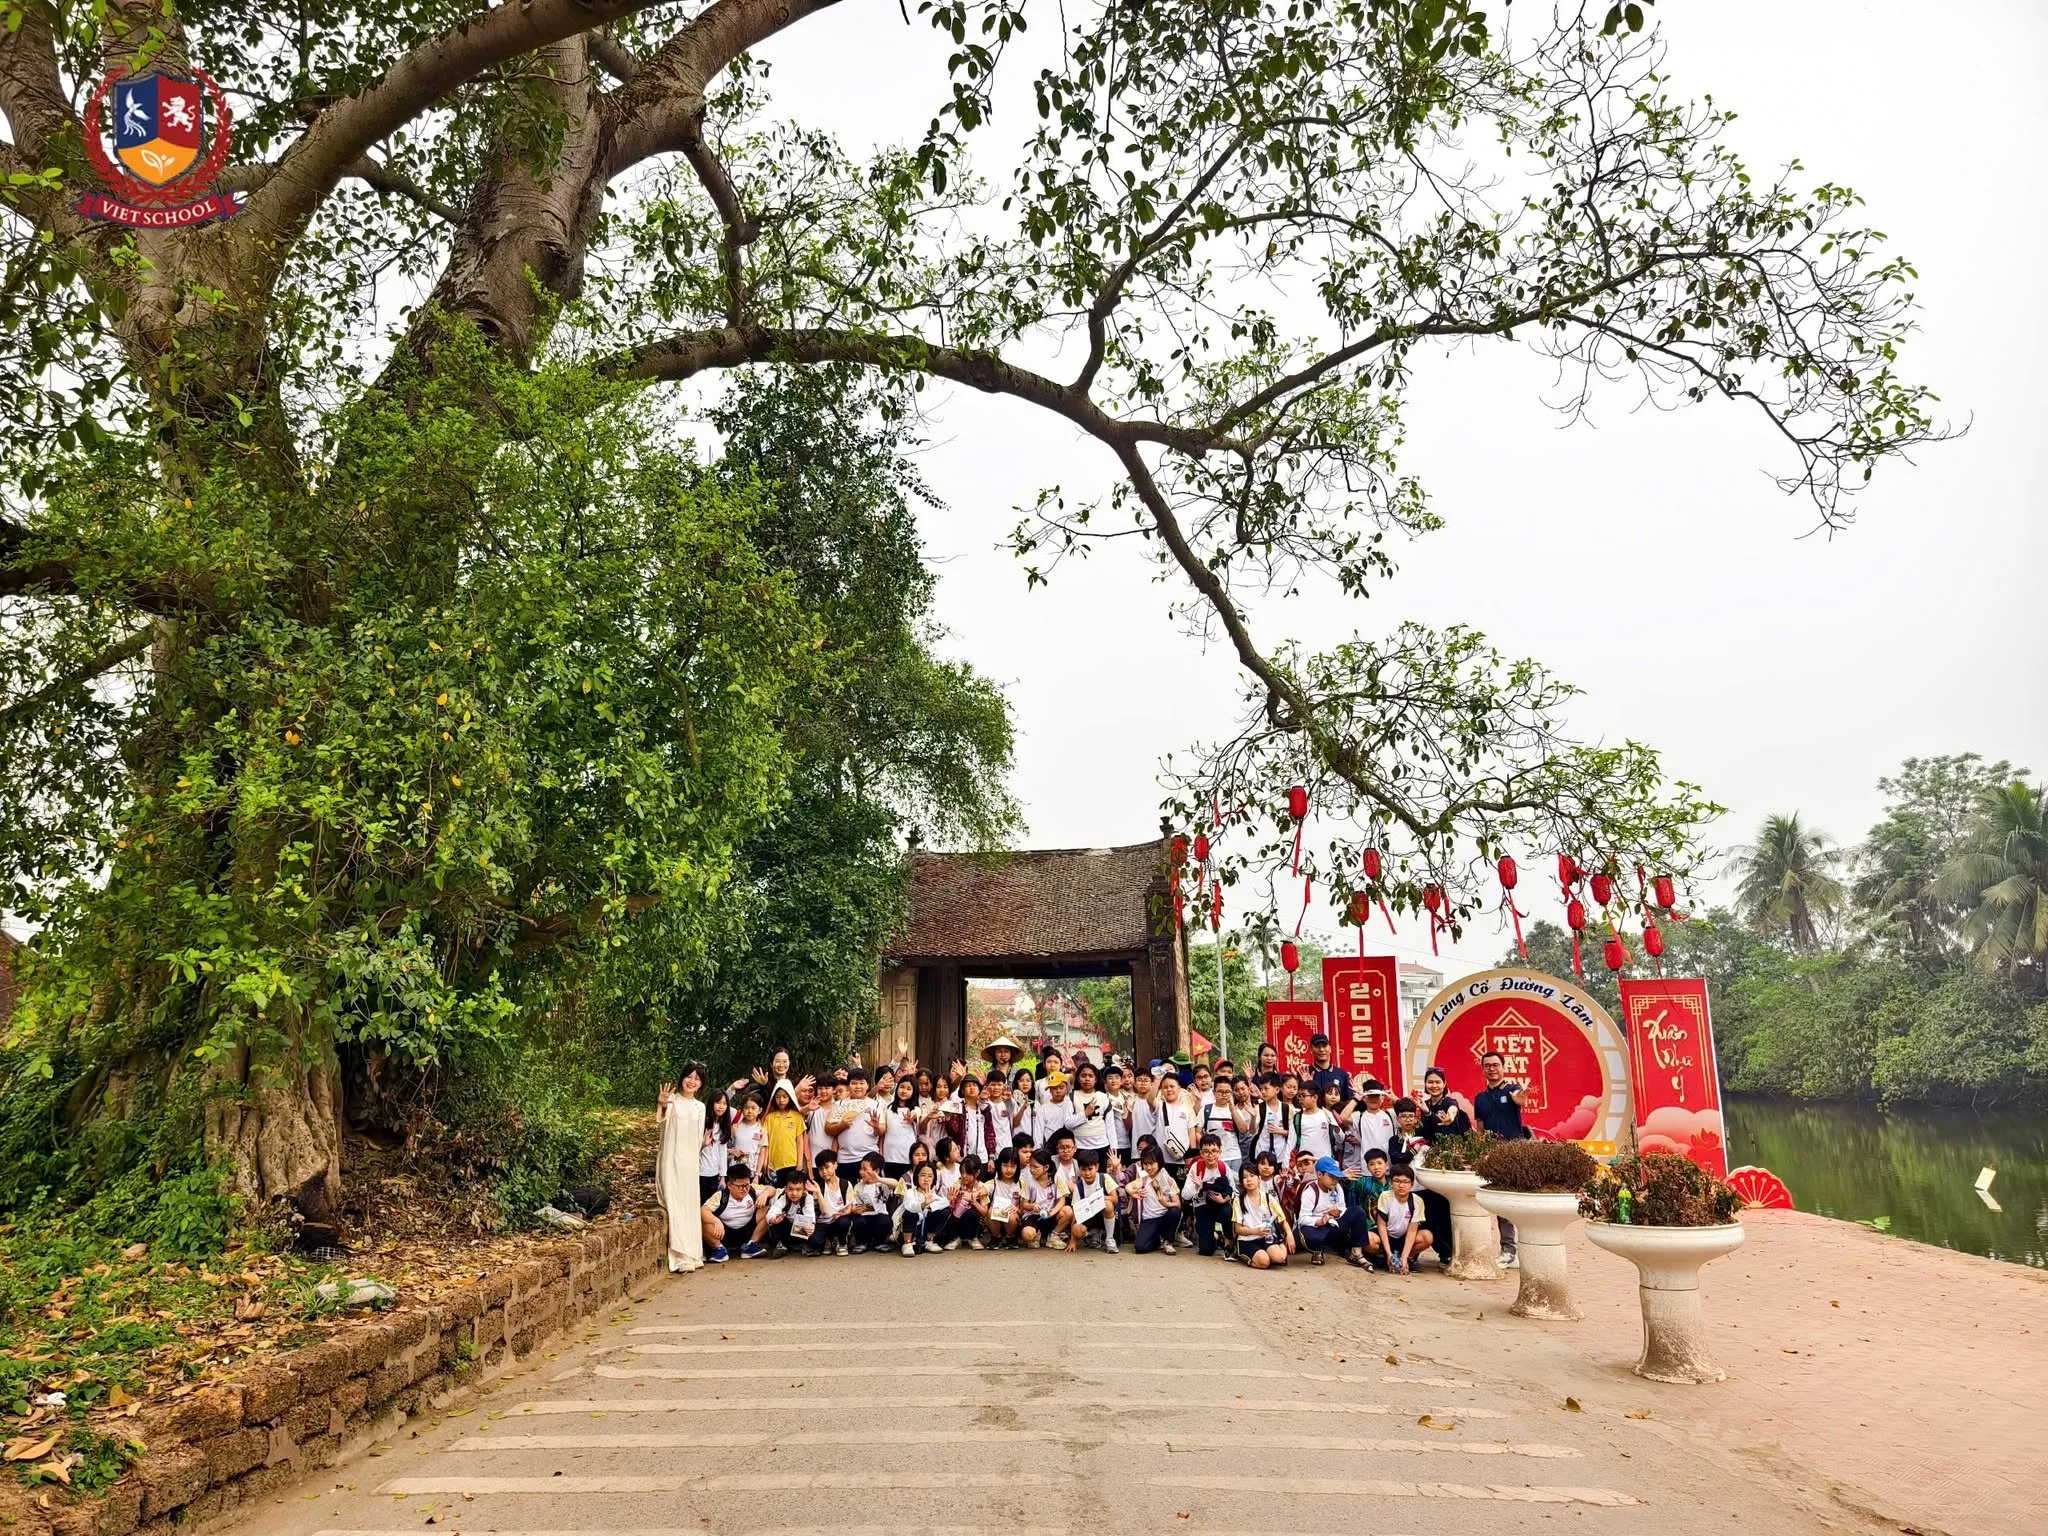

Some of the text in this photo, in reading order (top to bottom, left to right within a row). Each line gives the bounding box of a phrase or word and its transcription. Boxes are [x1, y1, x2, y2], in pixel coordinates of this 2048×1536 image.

[1349, 982, 1374, 1064] 2025
[1431, 977, 1593, 1028] Làng Cổ Đường Lâm
[1493, 1032, 1535, 1053] TẾT
